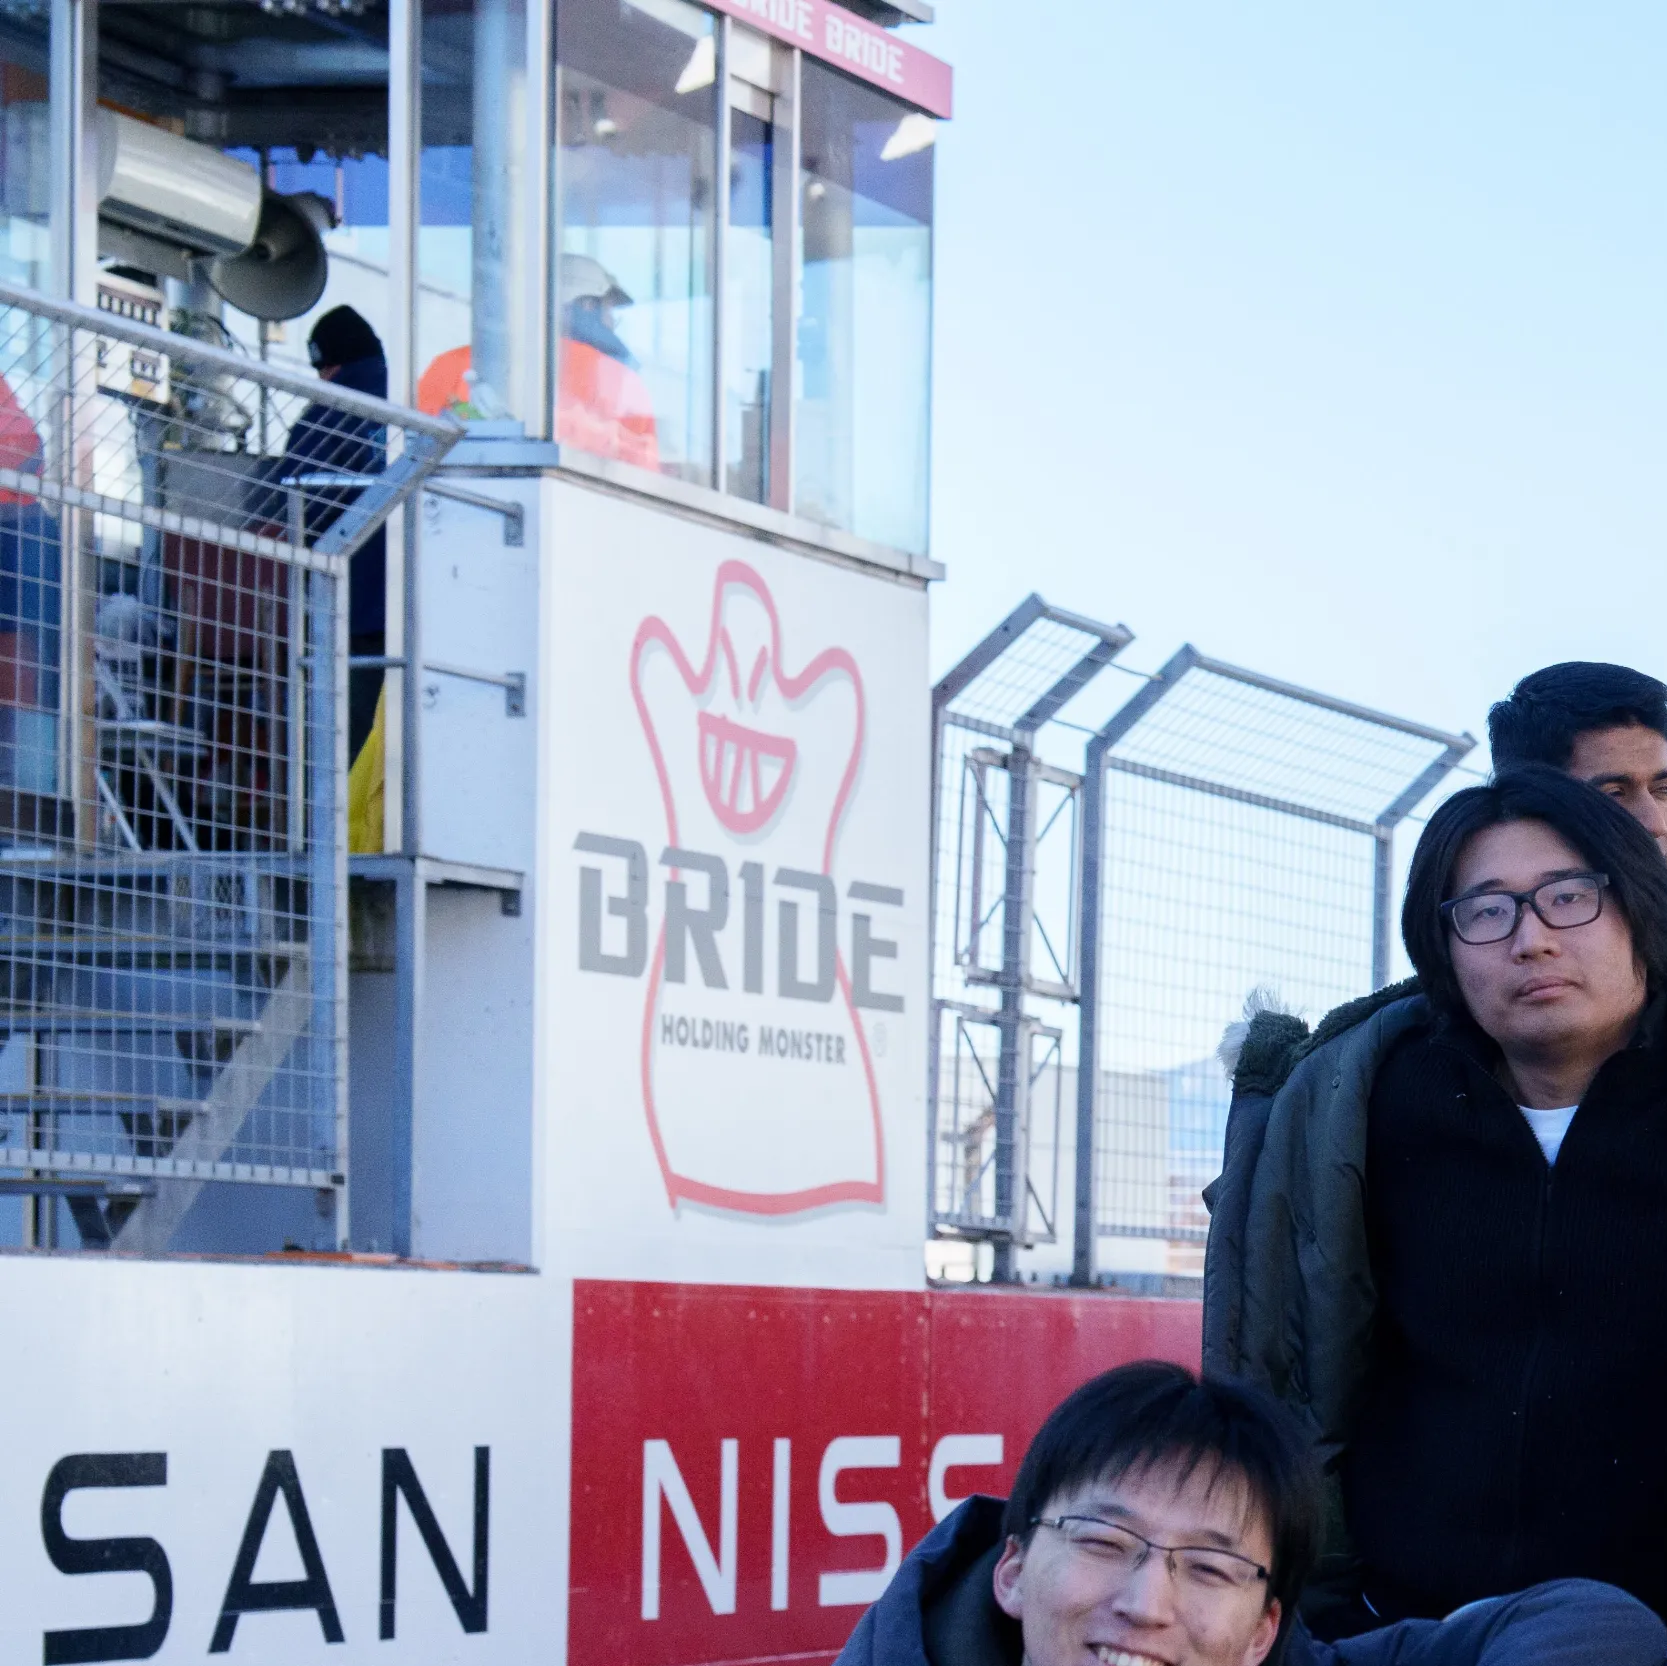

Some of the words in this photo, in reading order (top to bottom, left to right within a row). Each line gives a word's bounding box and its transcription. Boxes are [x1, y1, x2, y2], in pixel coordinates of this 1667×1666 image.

[824, 13, 904, 84] BRIDE
[573, 831, 905, 1014] BRIDE
[661, 1013, 750, 1053] HOLDING
[758, 1024, 847, 1065] MONSTER
[41, 1445, 490, 1666] SAN
